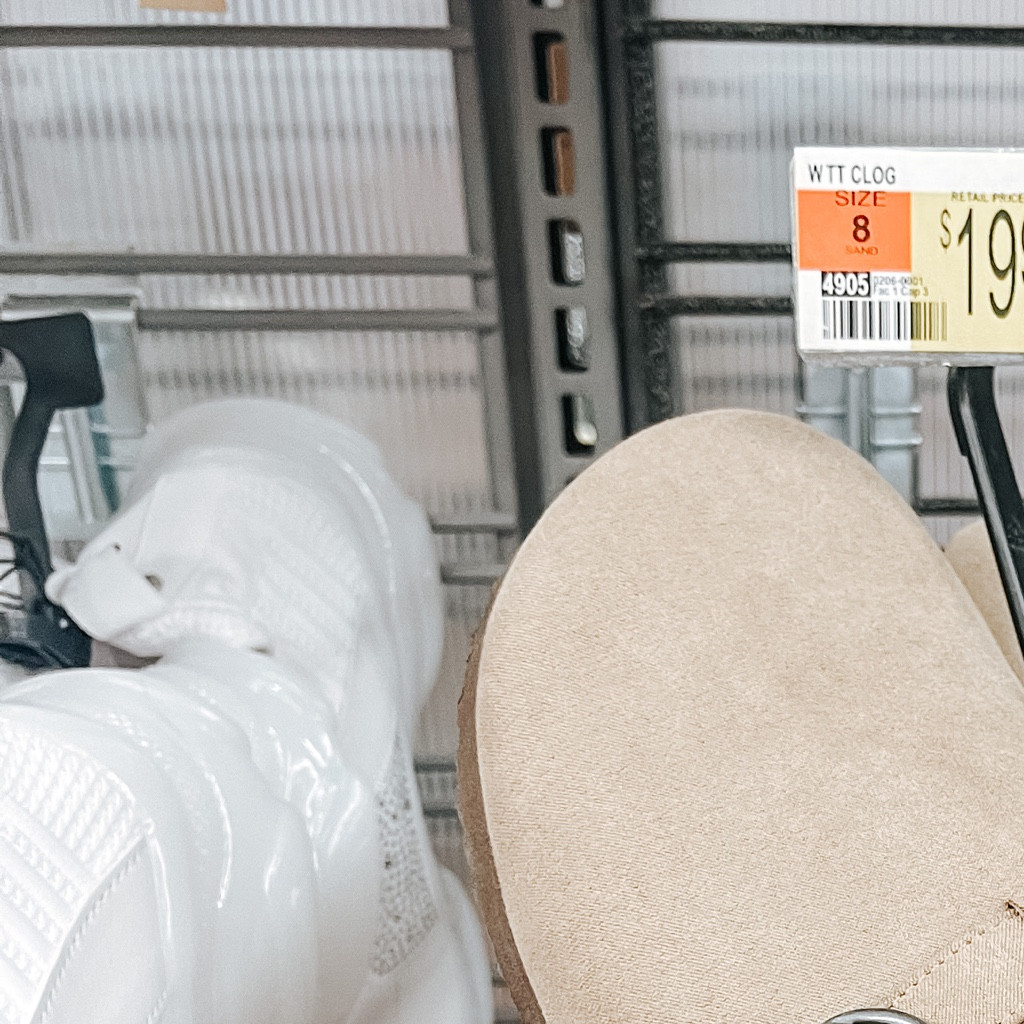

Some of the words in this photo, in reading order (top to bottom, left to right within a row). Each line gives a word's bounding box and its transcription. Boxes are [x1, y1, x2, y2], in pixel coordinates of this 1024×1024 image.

[808, 164, 846, 184] WTT
[851, 165, 896, 185] CLOG
[835, 189, 887, 208] SIZE
[951, 191, 989, 203] RETAIL
[992, 192, 1024, 204] PRICE
[852, 214, 871, 243] 8
[821, 271, 870, 297] 4905
